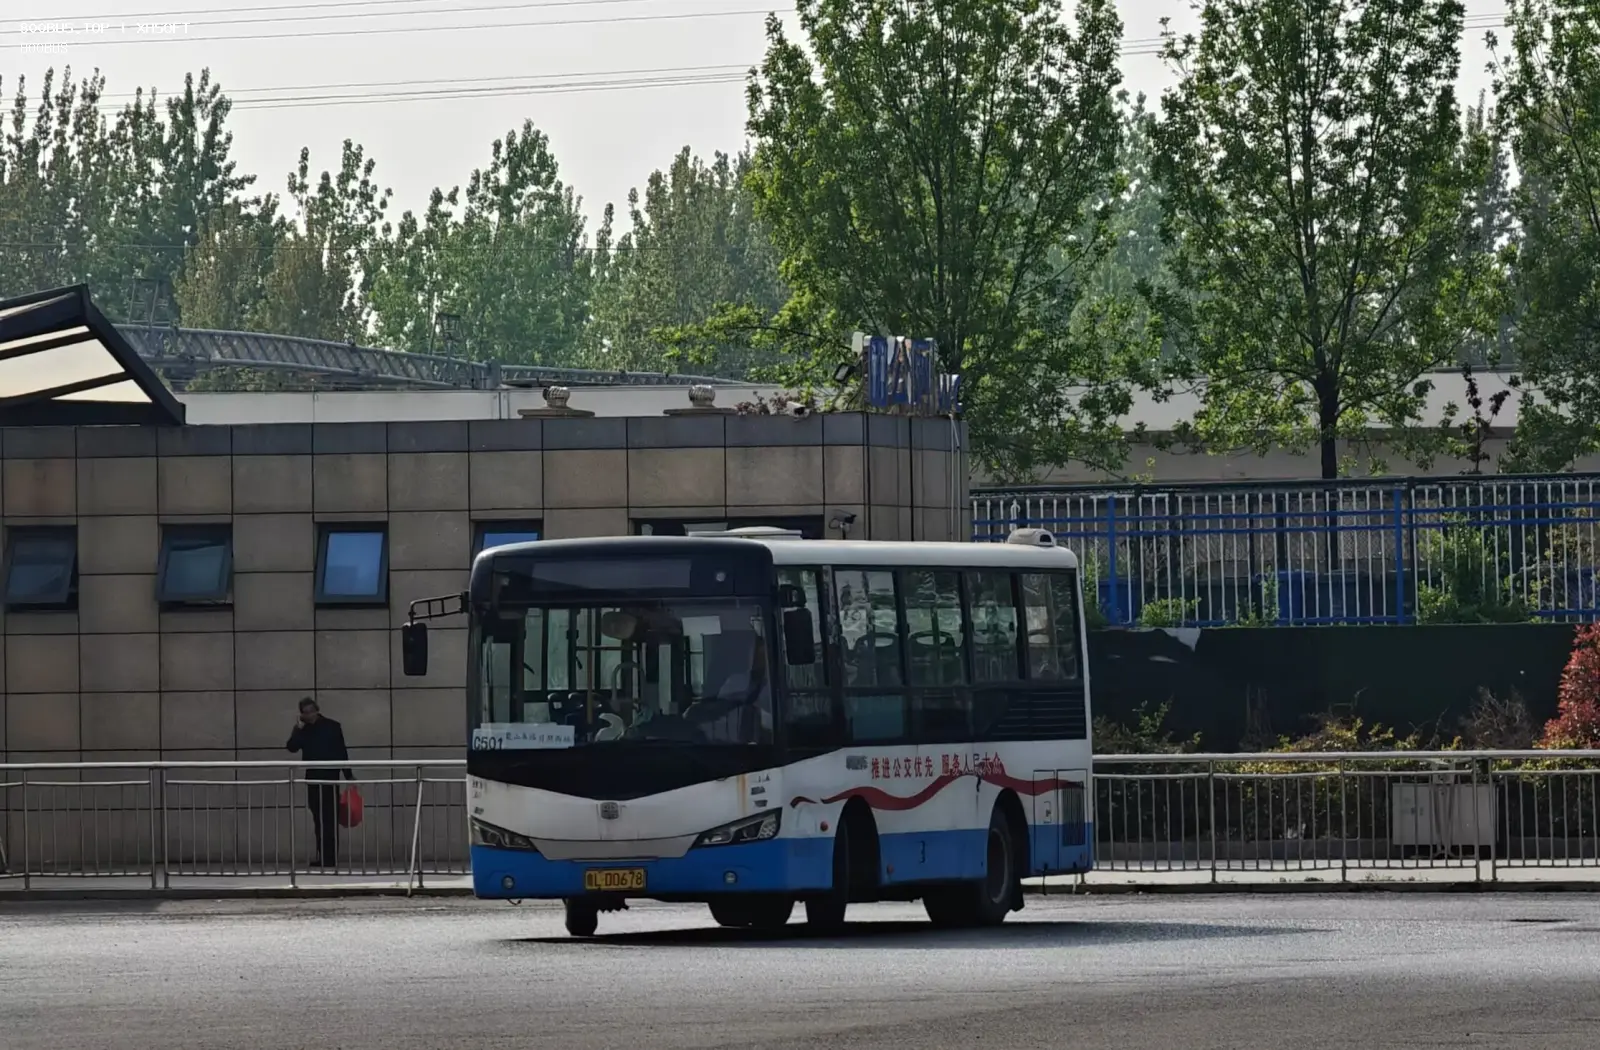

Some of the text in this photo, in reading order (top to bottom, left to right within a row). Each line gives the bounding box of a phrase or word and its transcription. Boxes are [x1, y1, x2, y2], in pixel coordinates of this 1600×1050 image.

[473, 736, 504, 751] C501
[871, 755, 934, 780] 推进公交优先
[586, 871, 643, 887] L00678
